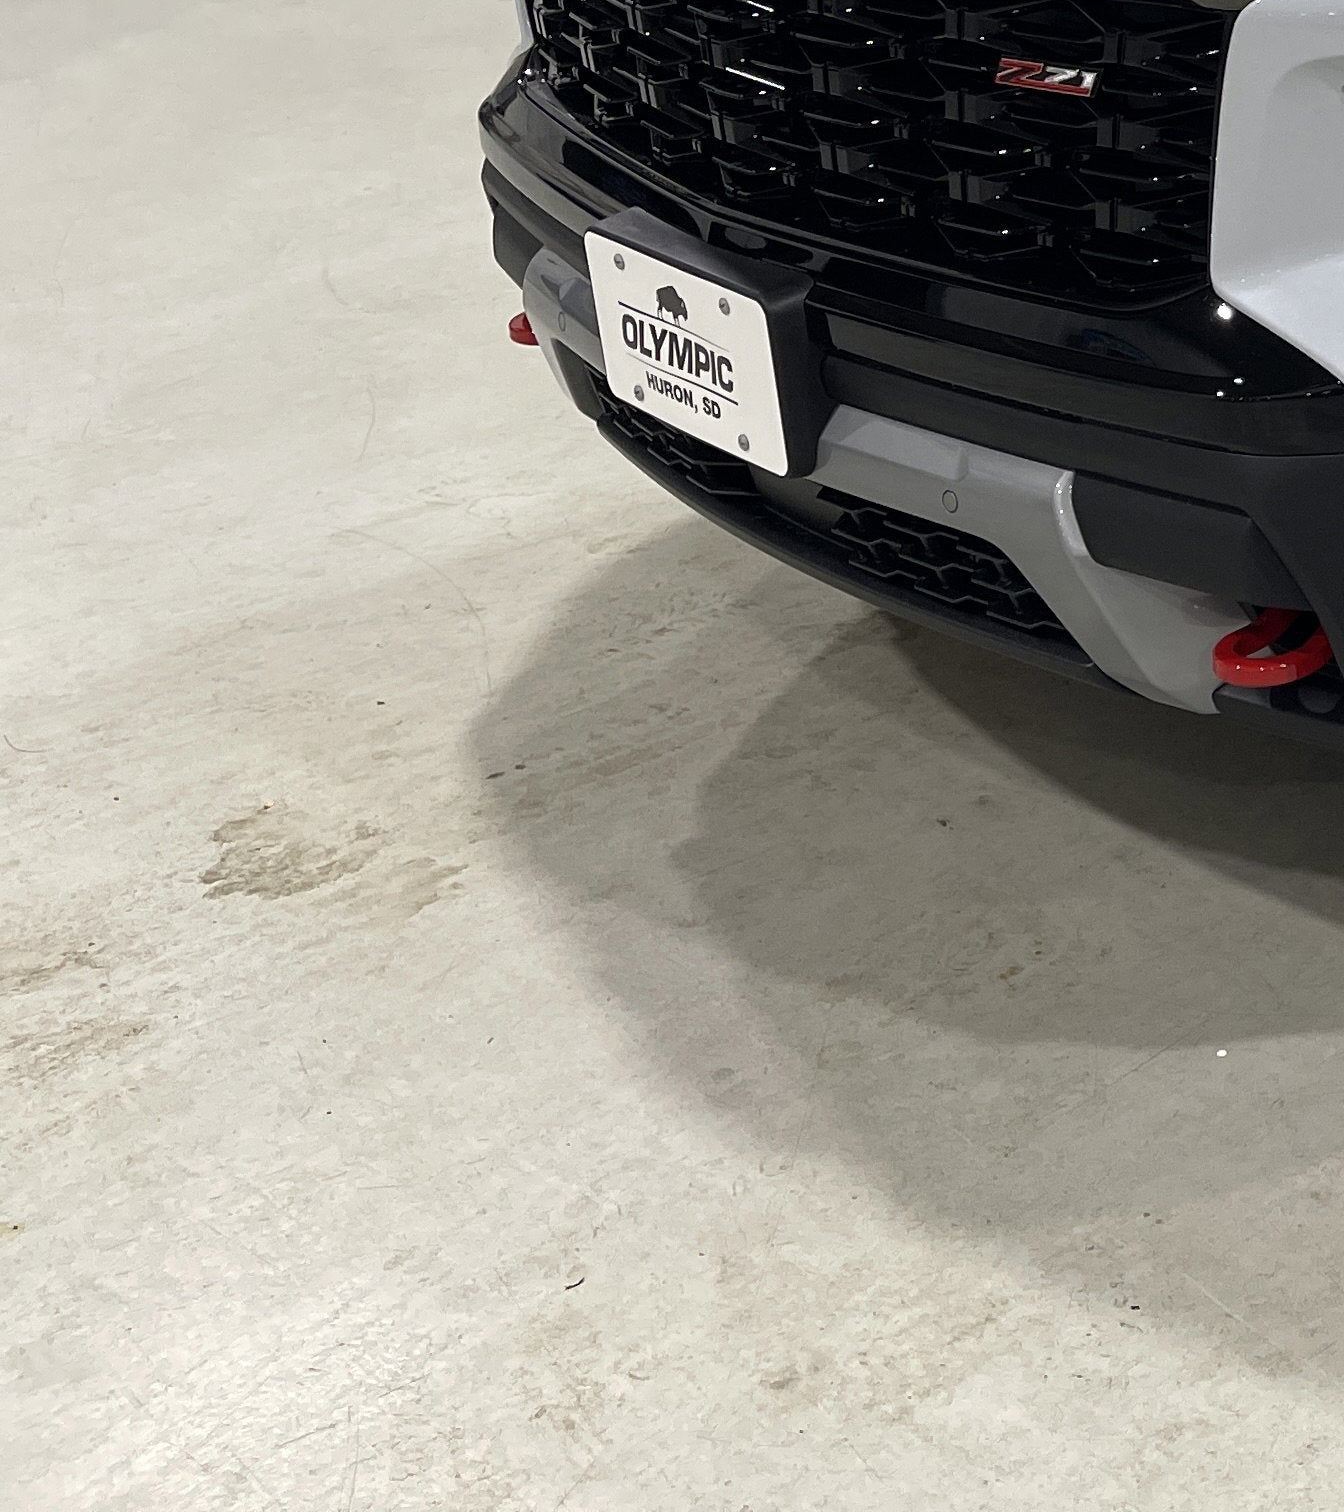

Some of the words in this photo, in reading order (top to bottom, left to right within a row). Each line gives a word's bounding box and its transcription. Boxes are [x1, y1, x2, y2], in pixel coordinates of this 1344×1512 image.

[994, 57, 1098, 97] Z71
[621, 313, 734, 393] OLYMPIC
[646, 370, 699, 414] HURON,
[702, 396, 722, 419] SD
